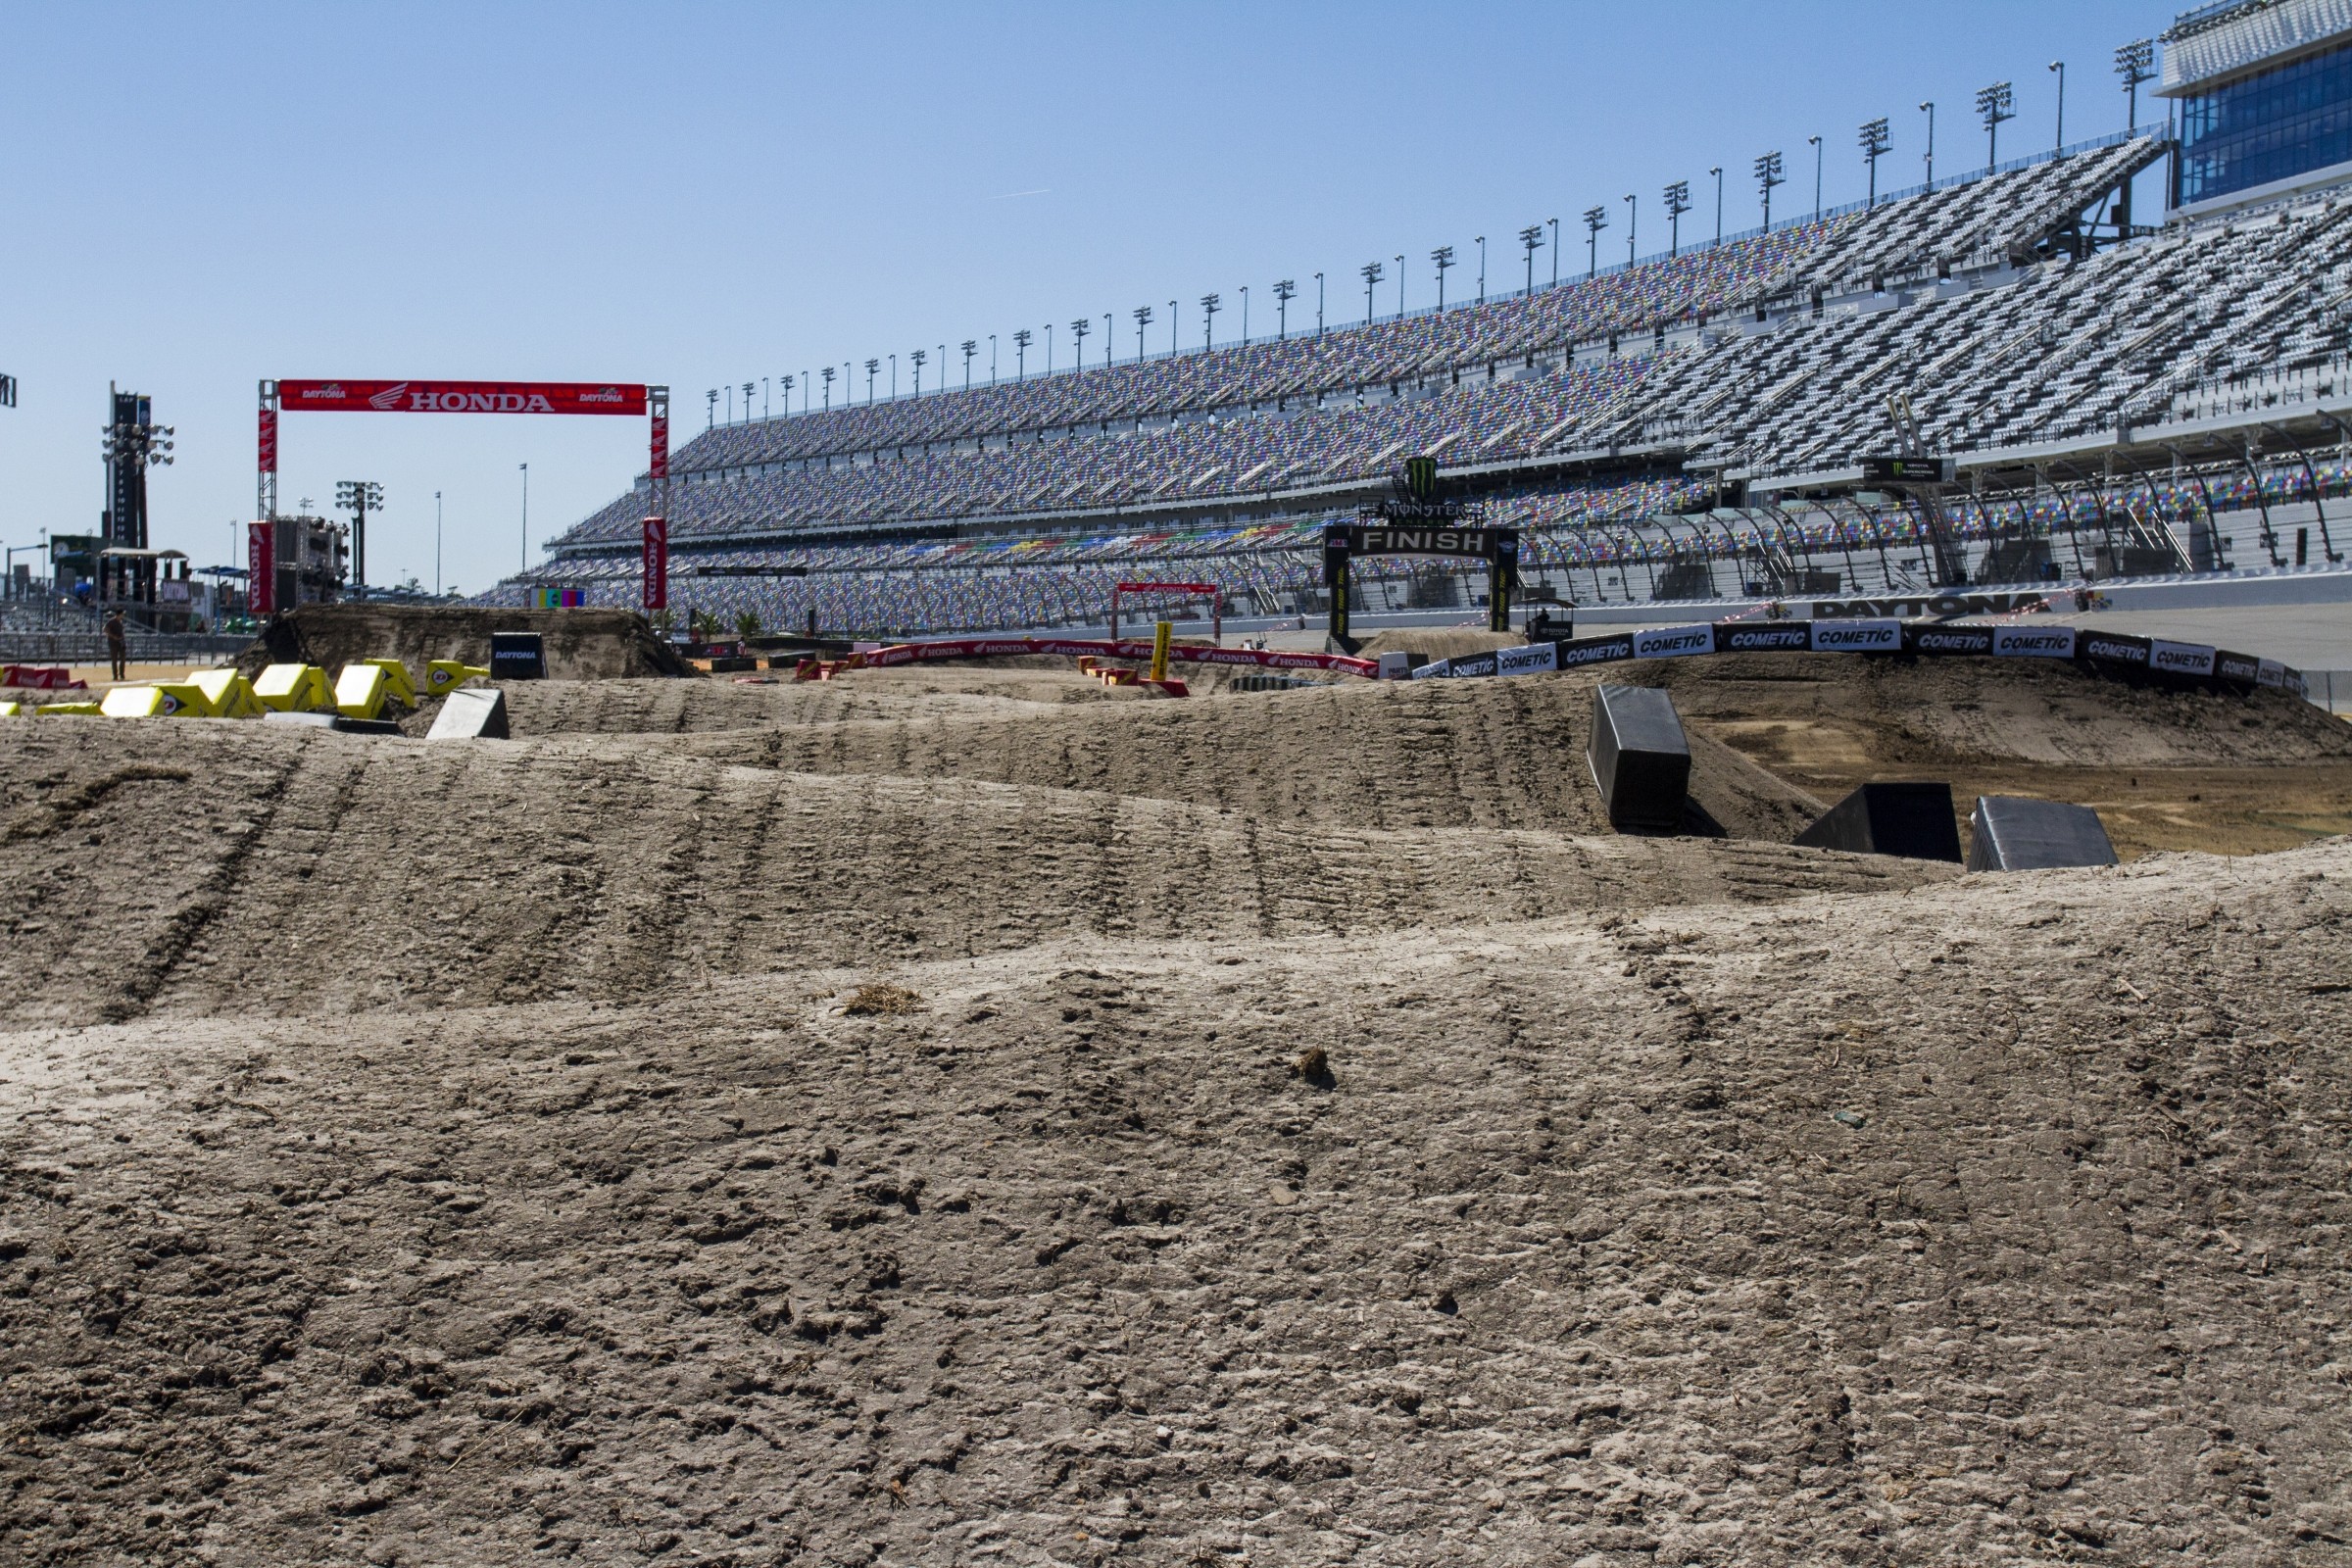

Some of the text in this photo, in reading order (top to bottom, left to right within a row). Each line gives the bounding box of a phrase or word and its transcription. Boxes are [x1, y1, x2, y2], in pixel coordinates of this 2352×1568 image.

[302, 390, 623, 412] DAYTONA HONDA DAYTONA
[1384, 503, 1468, 517] MONSTER
[1362, 531, 1484, 552] FINISH
[251, 543, 261, 611] HONDA
[648, 541, 658, 607] HONDA
[1813, 592, 2052, 617] DAYTONA
[1640, 632, 1707, 654] COMETIC
[1731, 629, 1807, 647] COMETIC
[1818, 627, 1893, 644] COMETIC
[1919, 632, 1989, 650] COMETIC
[2000, 632, 2070, 651] COMETIC
[888, 650, 913, 662] HONDA
[927, 647, 963, 657] HONDA
[986, 645, 1030, 654] HONDA
[1055, 646, 1106, 656] HONDA
[1134, 647, 1185, 659] HODA
[1212, 653, 1258, 663] HONDA
[1501, 649, 1552, 668] COMETIC
[1567, 642, 1630, 662] COMETIC
[2088, 640, 2147, 661] COMETIC
[1279, 658, 1320, 668] HONDA
[1452, 659, 1494, 677] COMETIC
[2156, 650, 2211, 668] COMETIC
[1338, 662, 1365, 675] HONDA
[2222, 660, 2256, 678] COMETIC
